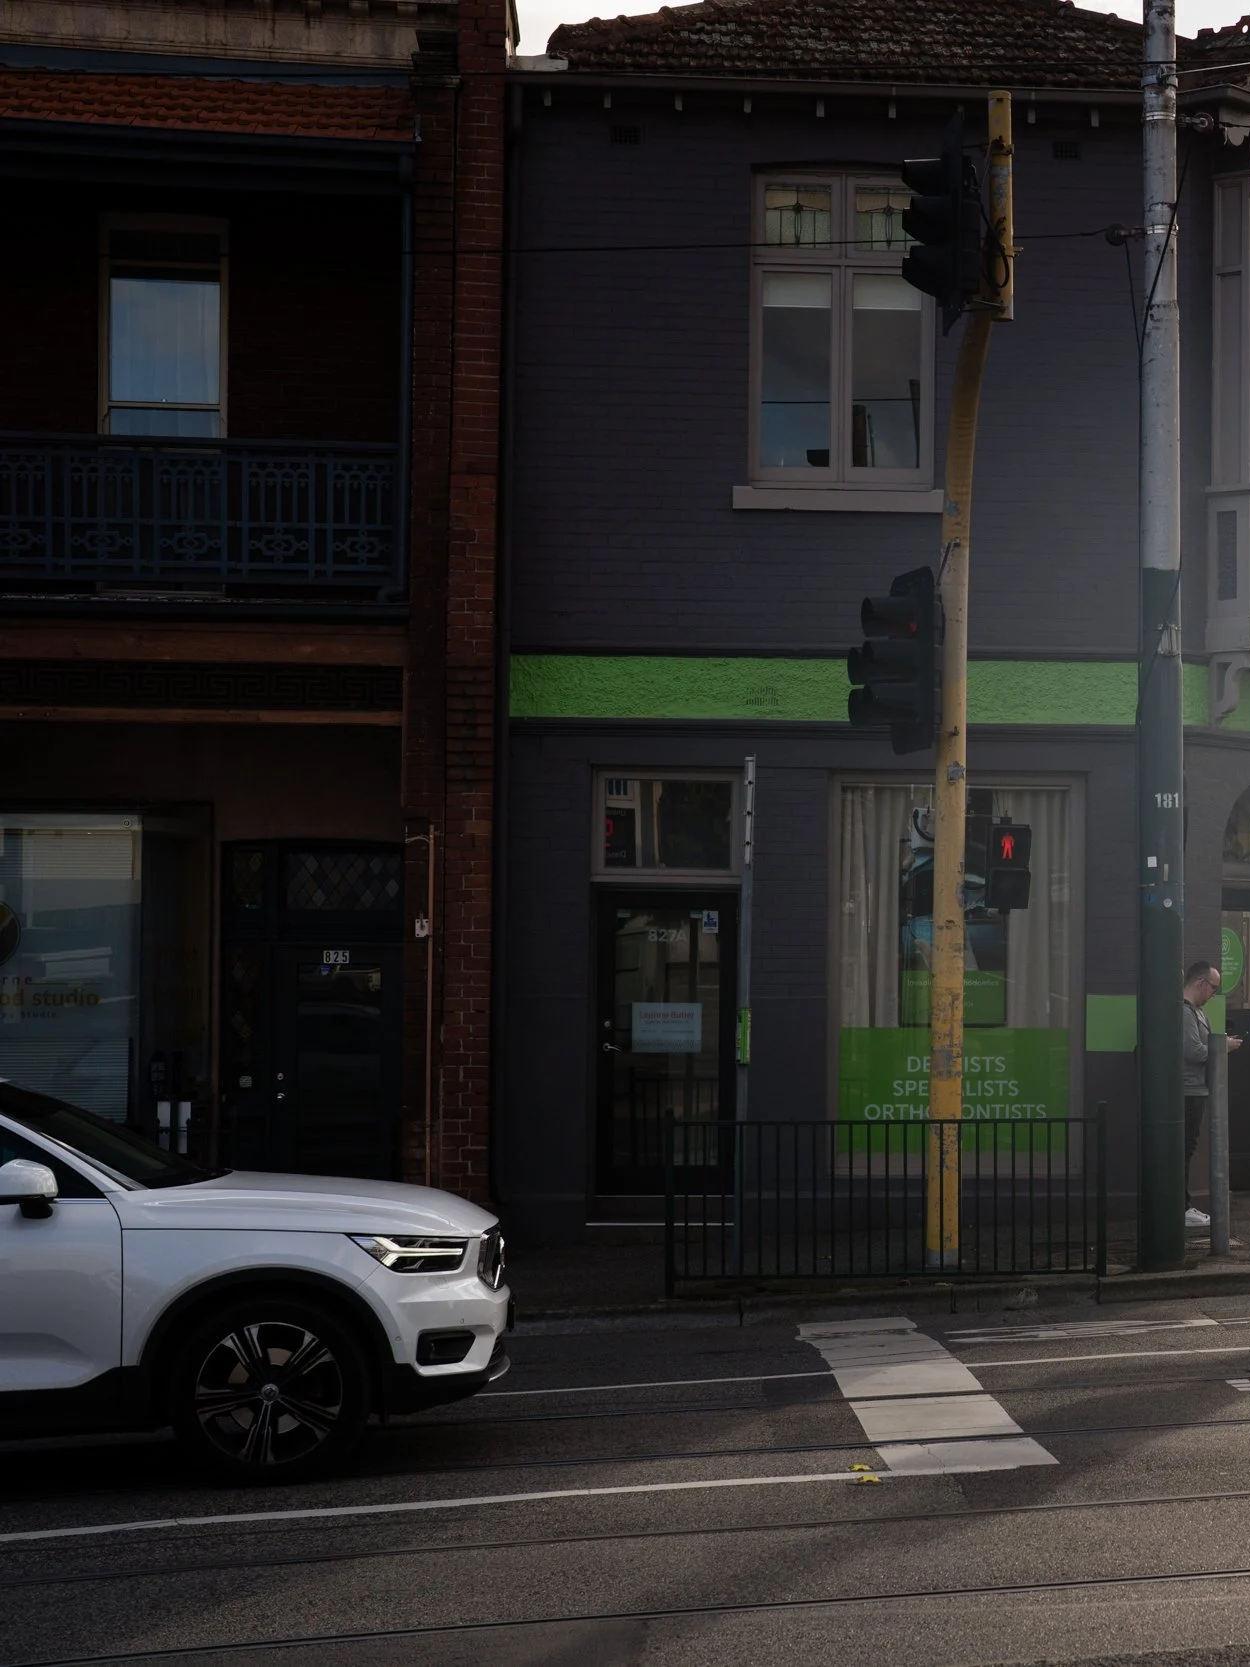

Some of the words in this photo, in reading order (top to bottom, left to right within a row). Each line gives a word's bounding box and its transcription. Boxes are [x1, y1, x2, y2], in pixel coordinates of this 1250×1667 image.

[1154, 792, 1179, 809] 181
[648, 929, 688, 942] 827A
[325, 951, 348, 963] 825
[32, 989, 100, 1007] studio
[906, 1055, 1006, 1073] DEISTS
[892, 1079, 1020, 1097] SPELISTS
[863, 1103, 1047, 1120] ORTHONTISTS
